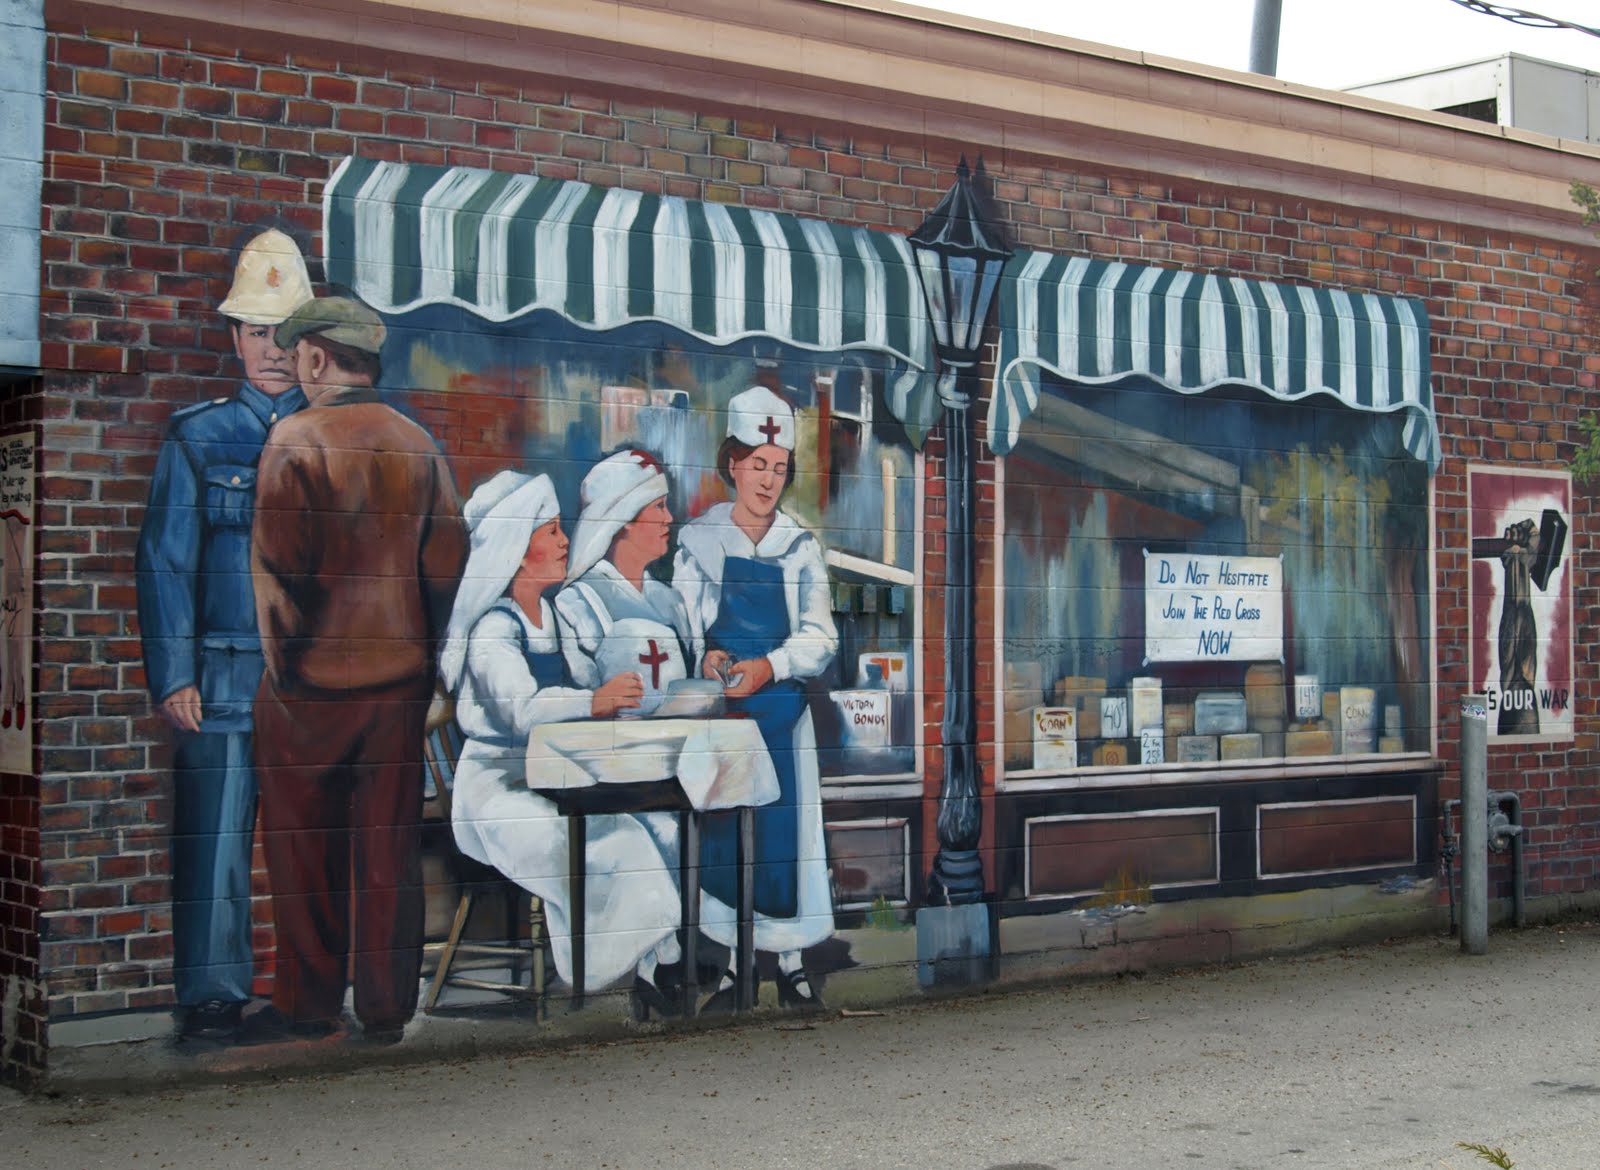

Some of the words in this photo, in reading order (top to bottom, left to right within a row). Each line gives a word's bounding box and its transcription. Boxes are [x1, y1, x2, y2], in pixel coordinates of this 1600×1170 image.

[1157, 559, 1176, 584] DO
[1185, 560, 1210, 585] NOT
[1218, 561, 1269, 586] HESITATE
[1162, 593, 1186, 620] JOIN
[1191, 595, 1208, 620] THE
[1213, 595, 1232, 620] RED
[1235, 598, 1261, 620] CROSS
[1197, 630, 1233, 656] NOW
[1503, 689, 1534, 711] OUR
[1540, 688, 1569, 710] WAR
[854, 713, 886, 727] BONDS
[1039, 718, 1067, 732] CORN
